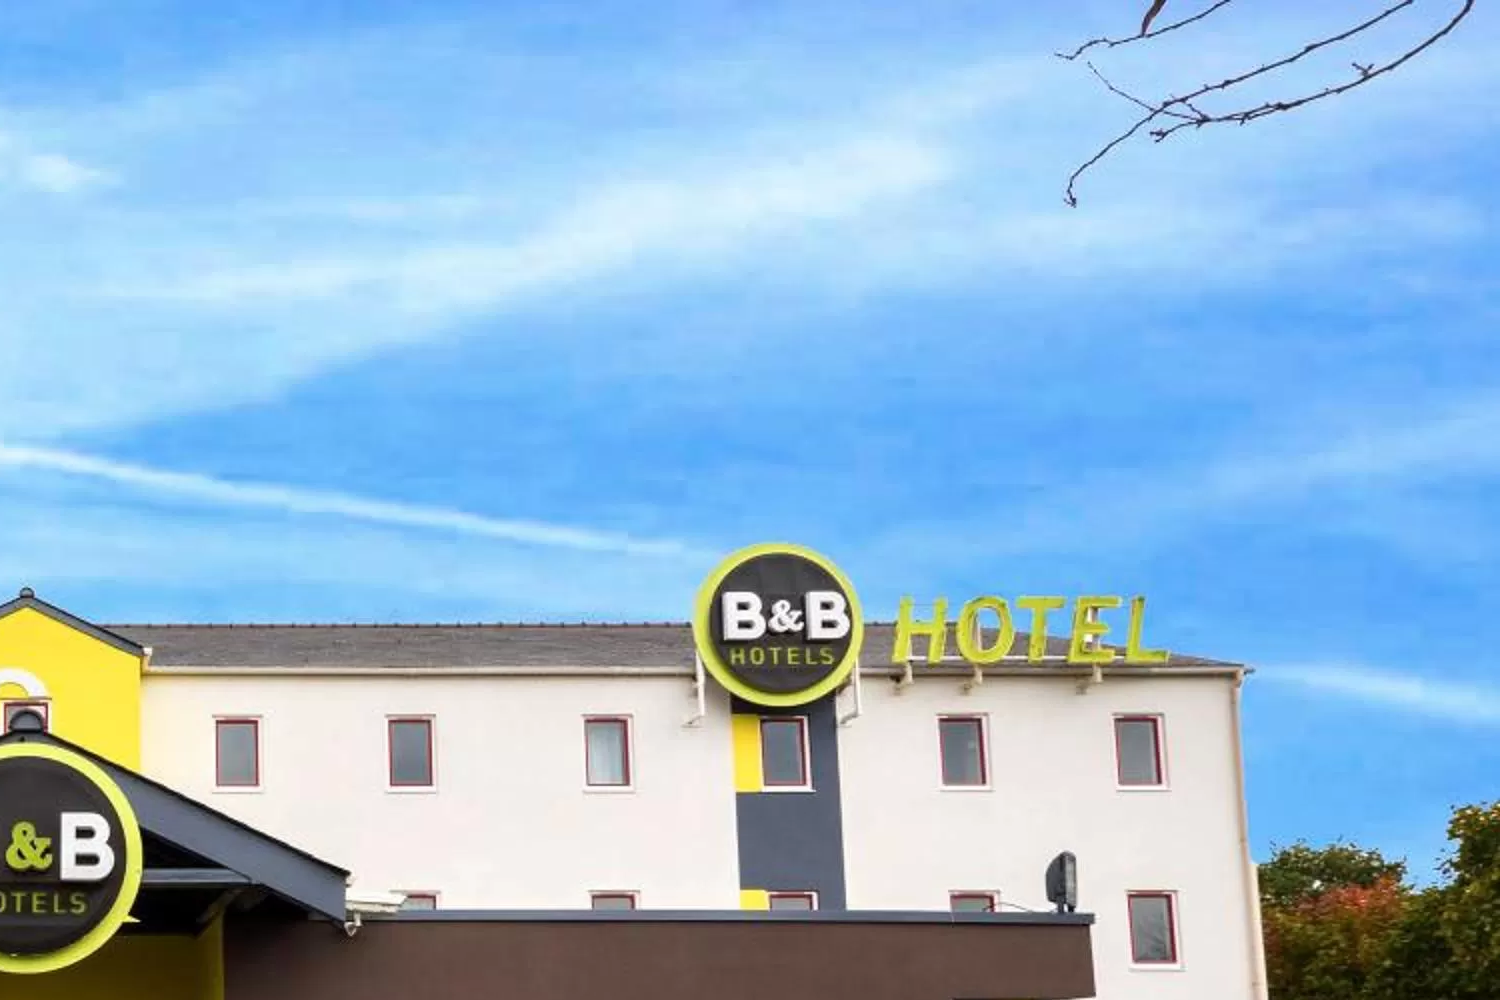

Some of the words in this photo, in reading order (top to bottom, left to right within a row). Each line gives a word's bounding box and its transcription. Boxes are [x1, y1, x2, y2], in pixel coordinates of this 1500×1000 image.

[722, 591, 850, 640] B&B
[892, 595, 1170, 664] HOTEL
[730, 647, 835, 665] HOTELS
